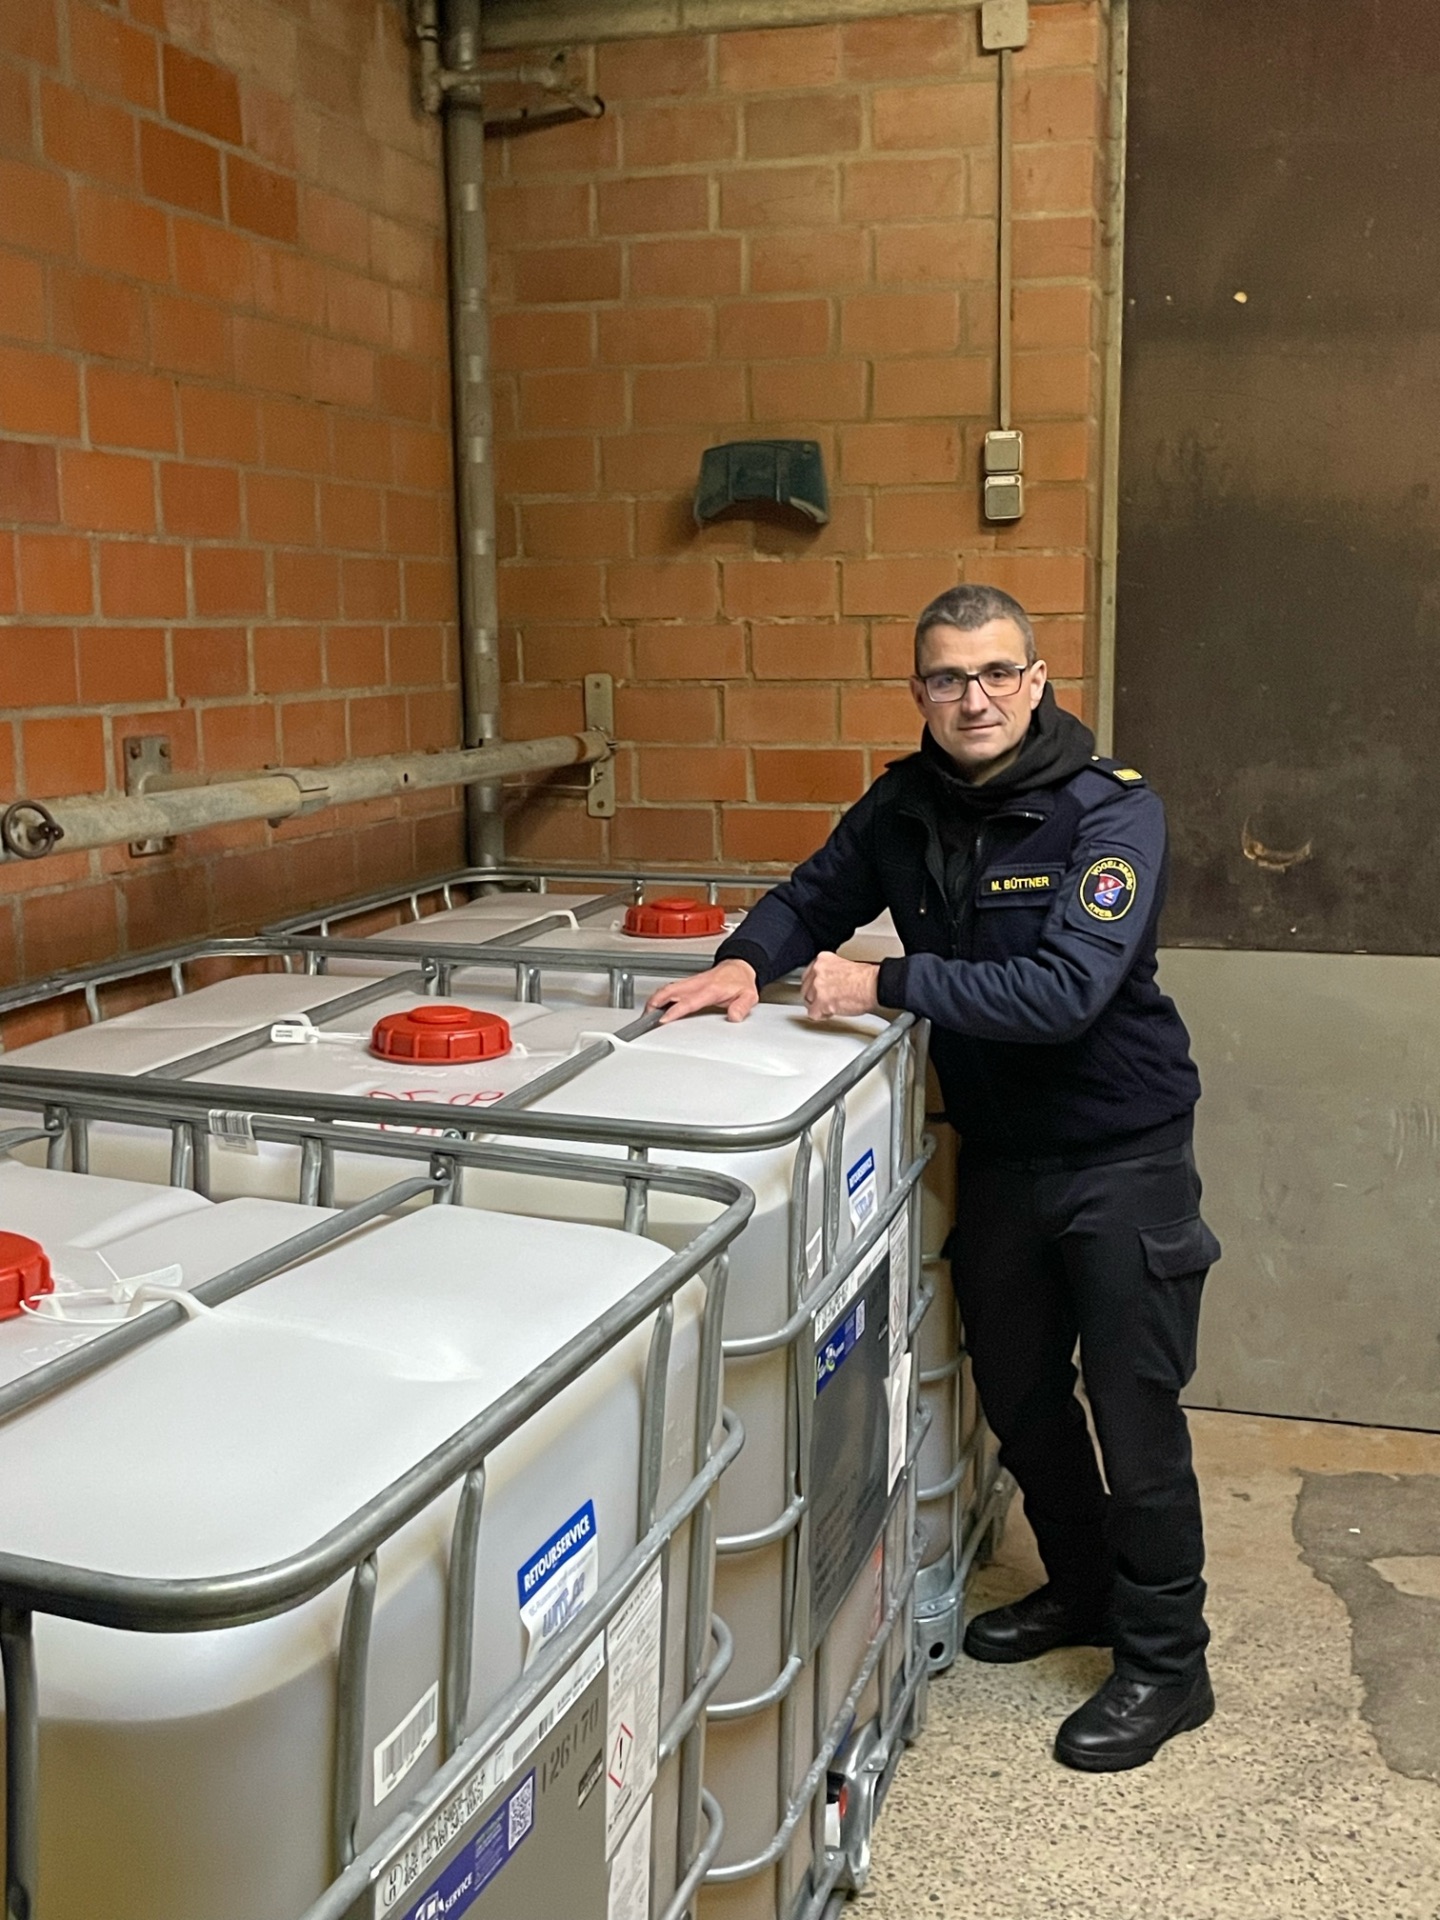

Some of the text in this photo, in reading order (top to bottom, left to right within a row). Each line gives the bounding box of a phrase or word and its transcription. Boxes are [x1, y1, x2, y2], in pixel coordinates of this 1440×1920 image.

[991, 876, 1050, 891] M. BÜTTNER
[523, 1514, 591, 1593] RETOURSERVICE
